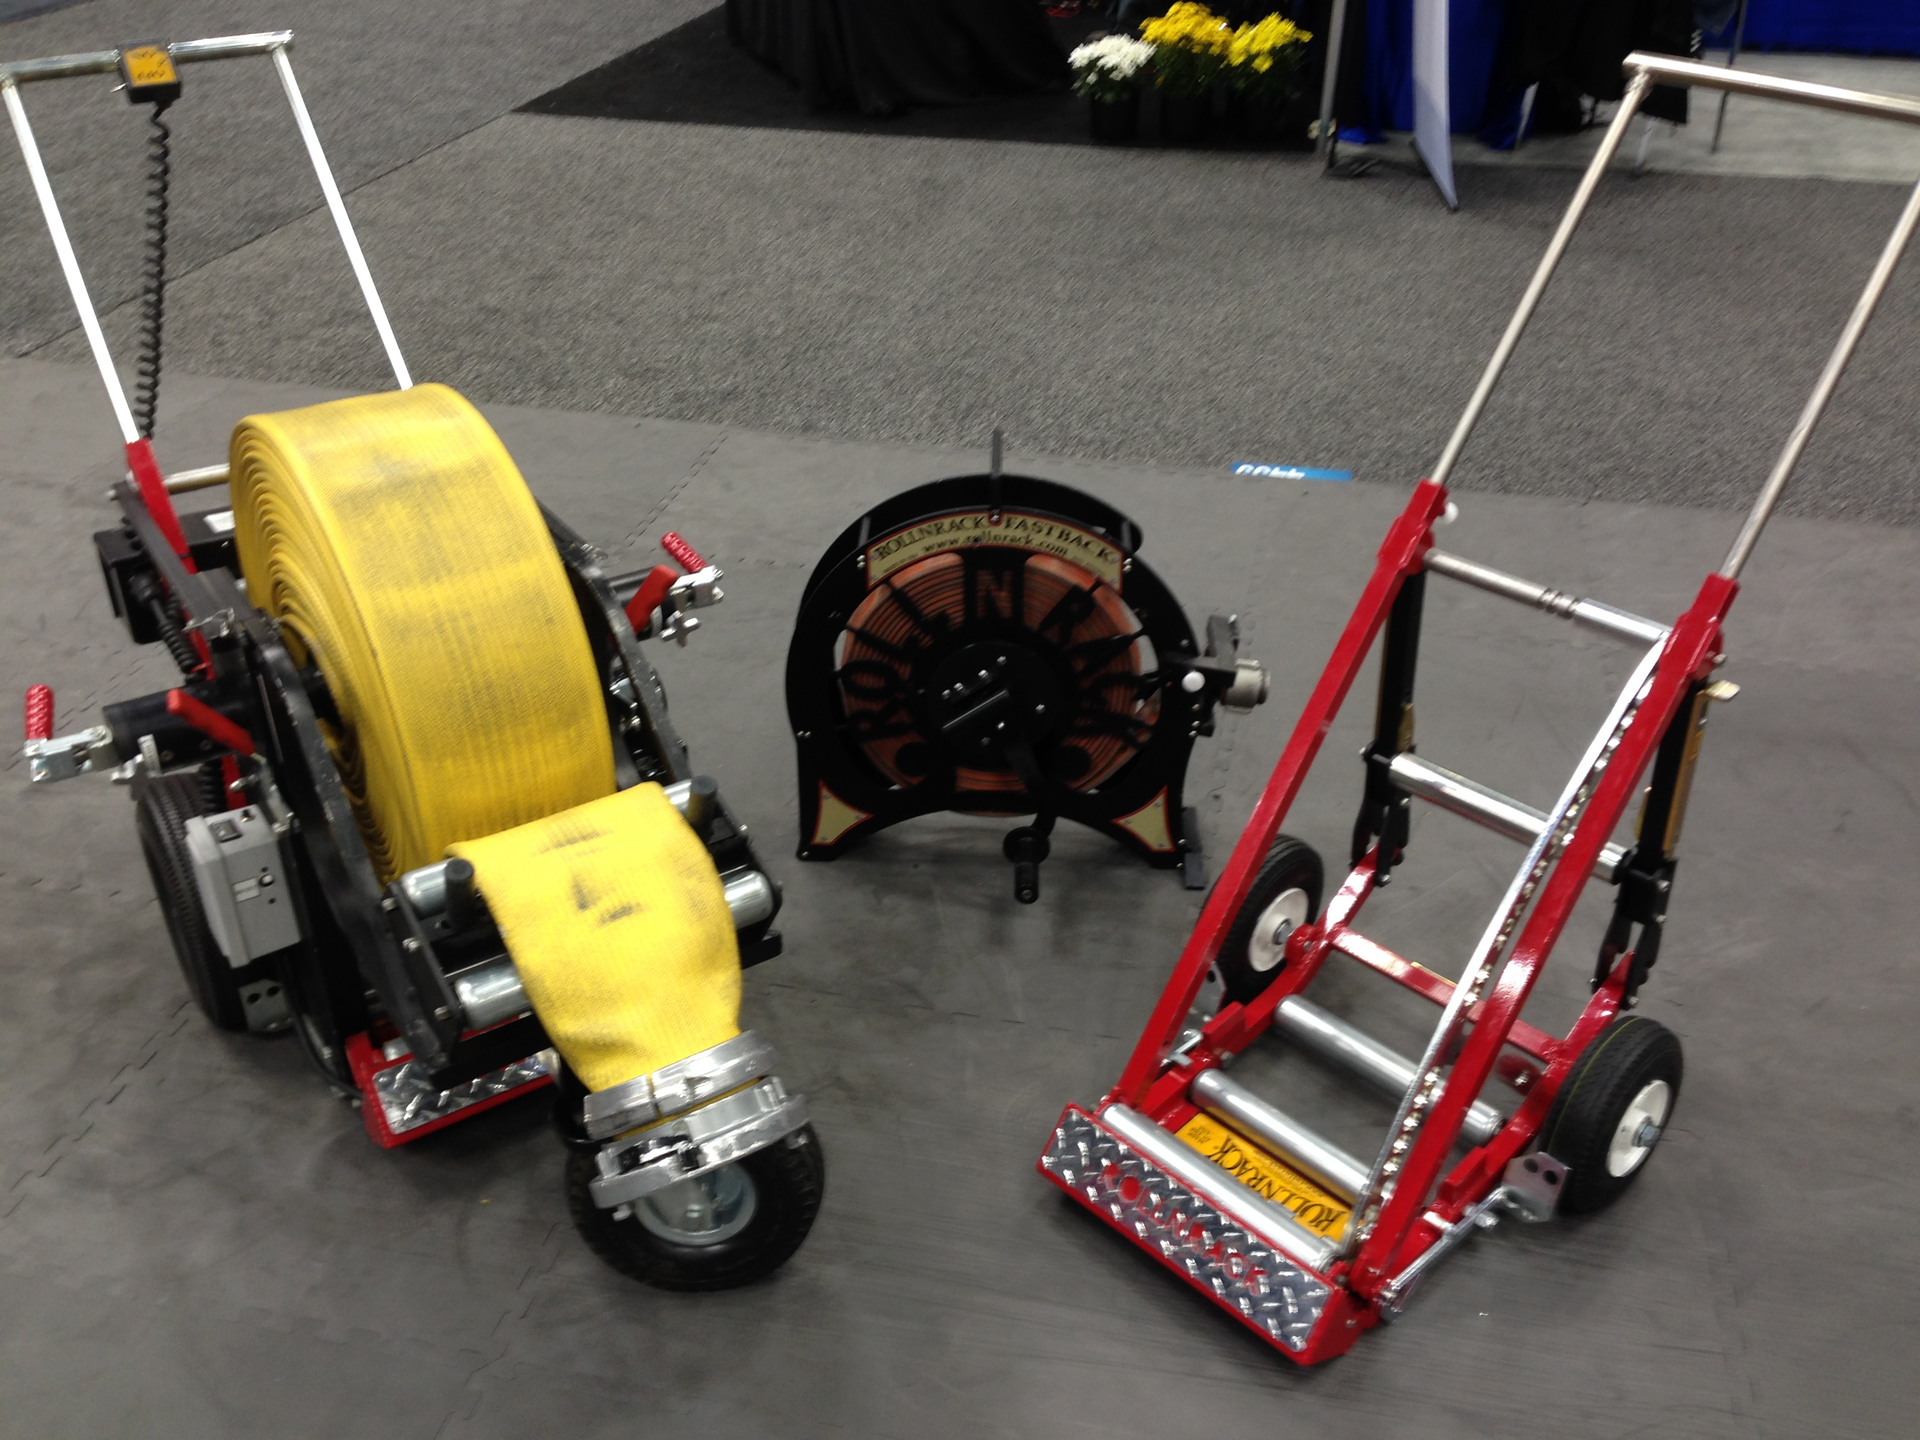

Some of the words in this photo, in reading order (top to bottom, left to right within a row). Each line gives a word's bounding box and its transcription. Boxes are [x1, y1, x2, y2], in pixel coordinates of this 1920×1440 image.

[873, 515, 987, 561] ROLLNRACK
[1003, 516, 1115, 561] FASTBACK
[1099, 1162, 1268, 1296] ROLLNRACK
[1205, 1135, 1347, 1232] ROLLNRACK
